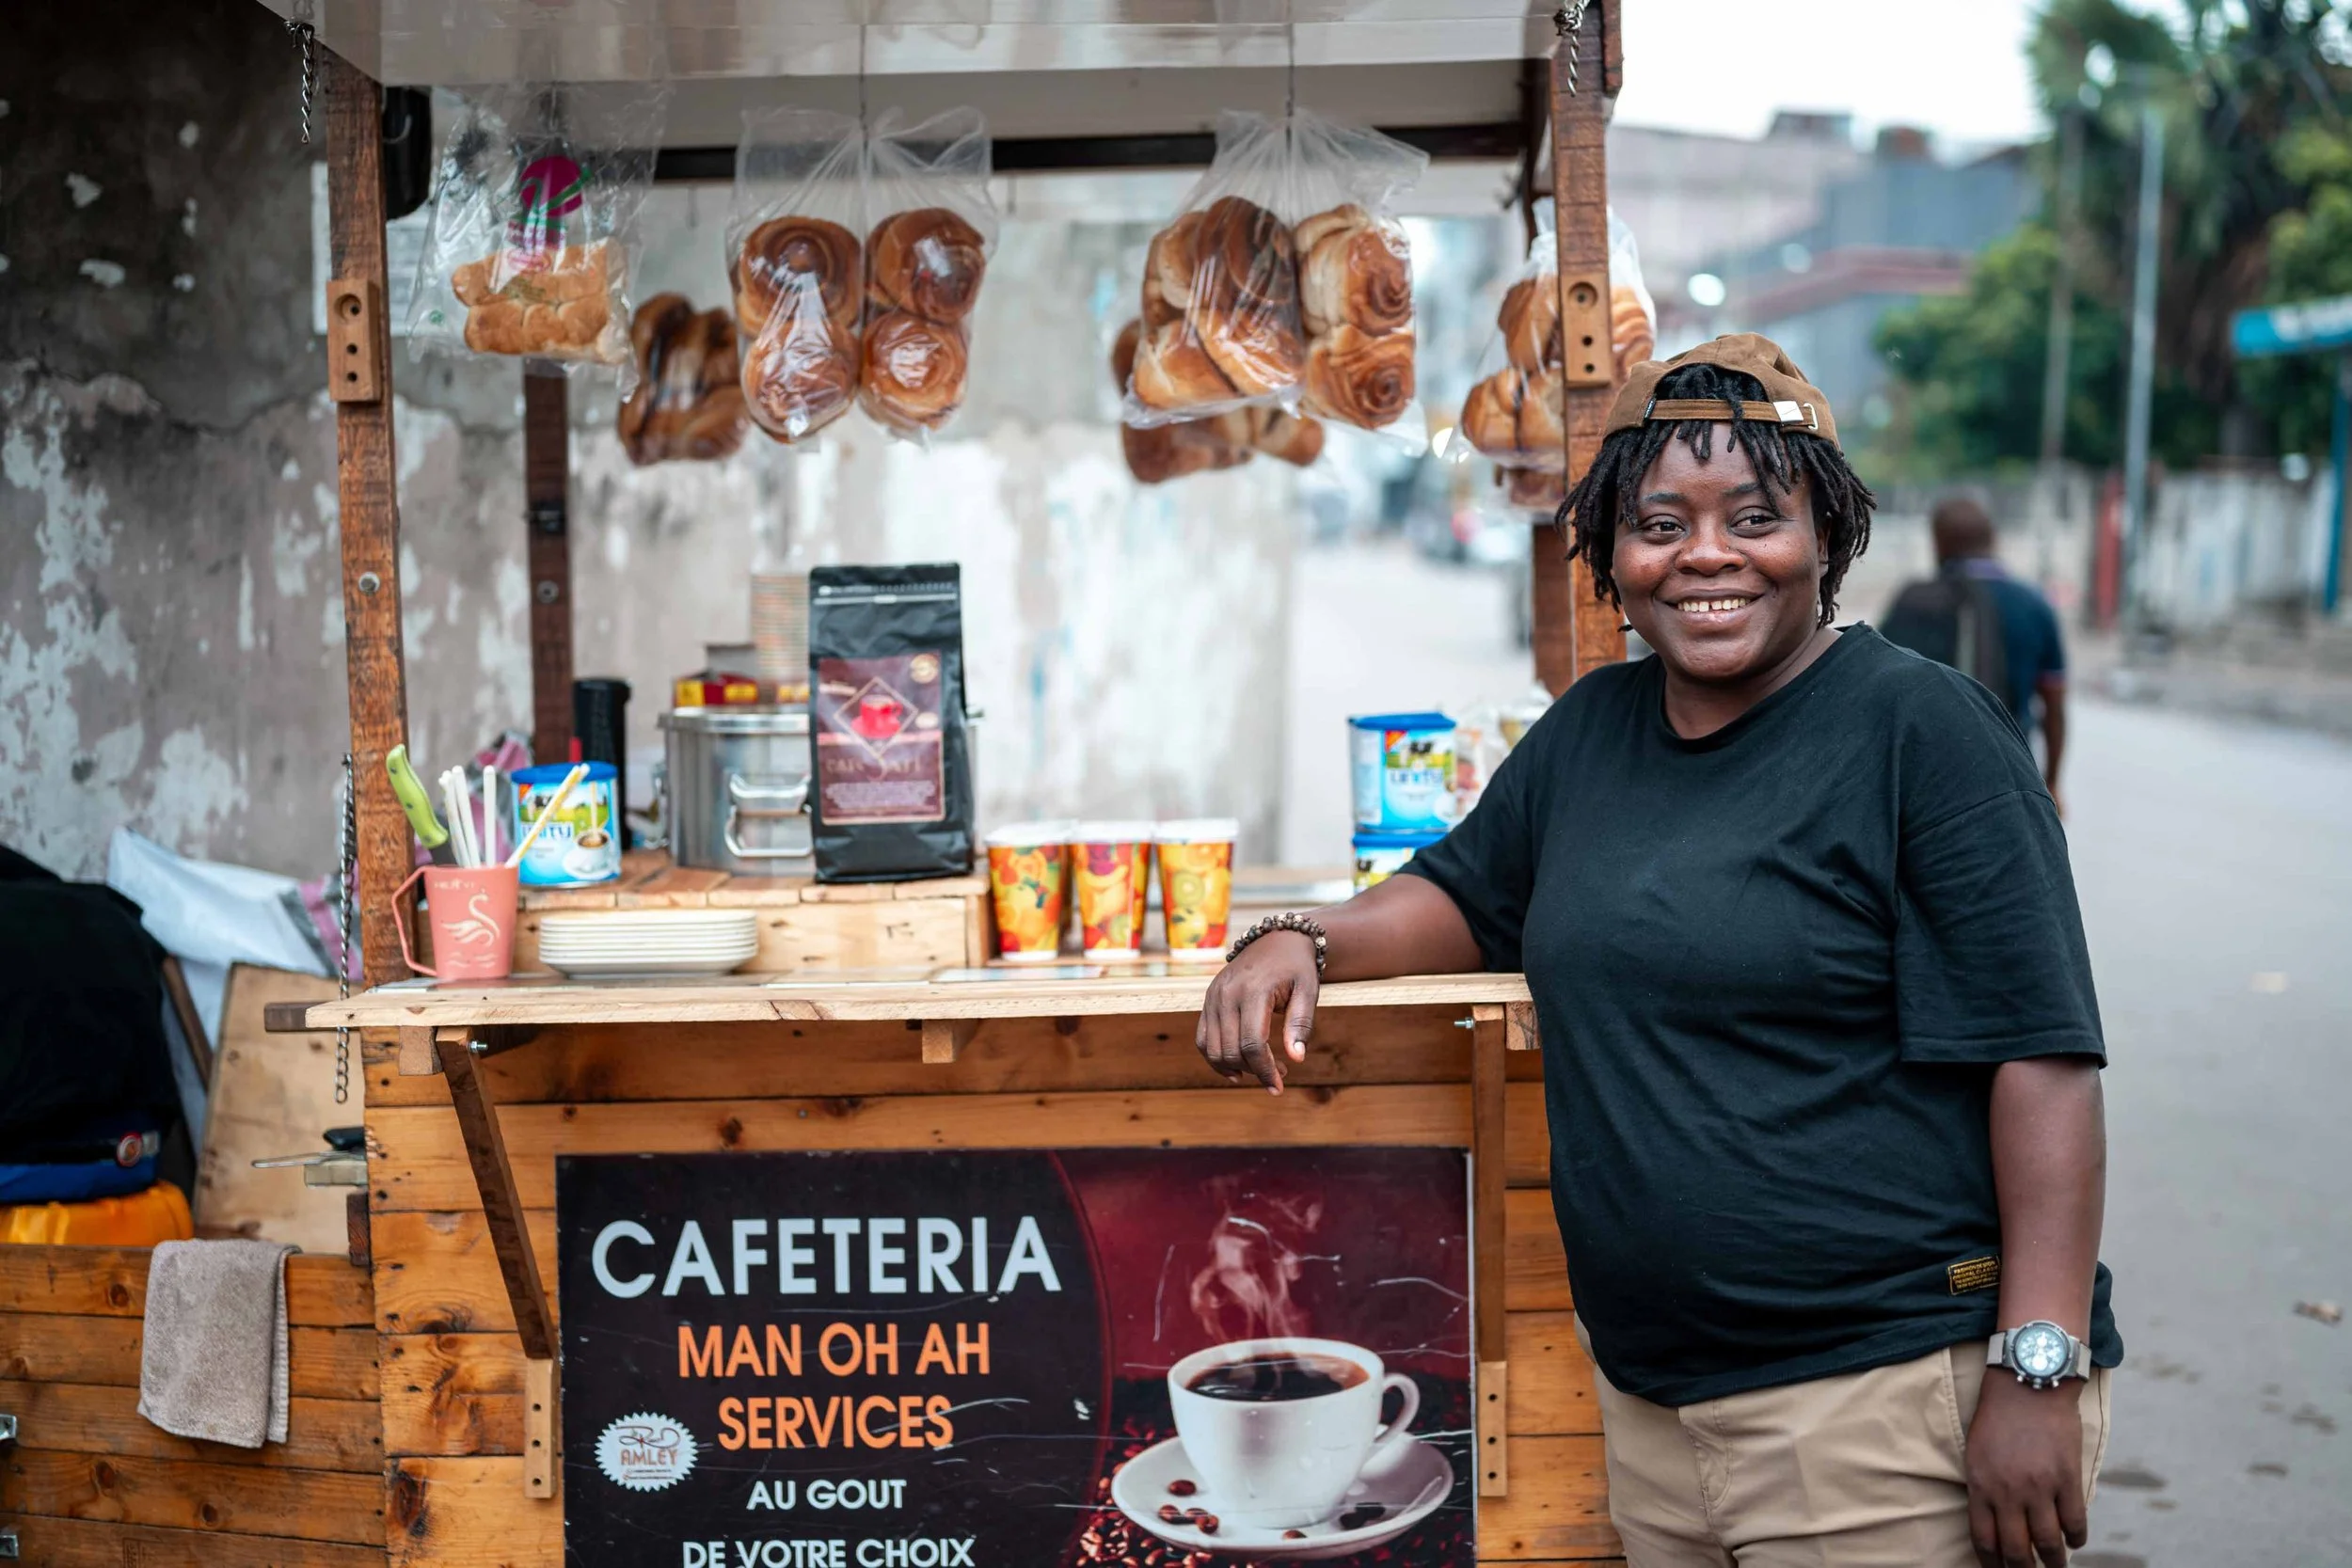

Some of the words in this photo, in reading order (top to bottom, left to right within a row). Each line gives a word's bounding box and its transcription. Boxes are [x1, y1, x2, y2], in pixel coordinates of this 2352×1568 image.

[592, 1217, 1062, 1298] CAFETERIA
[678, 1324, 803, 1378] MAN
[818, 1323, 898, 1376] OH
[915, 1323, 990, 1375] AH
[718, 1395, 953, 1450] SERVICES
[621, 1449, 678, 1465] AMLEY
[746, 1480, 796, 1511] AU
[806, 1479, 907, 1510] GOUT
[682, 1541, 726, 1568] DE
[735, 1539, 847, 1568] VOTRE
[855, 1538, 976, 1568] CHOIX
